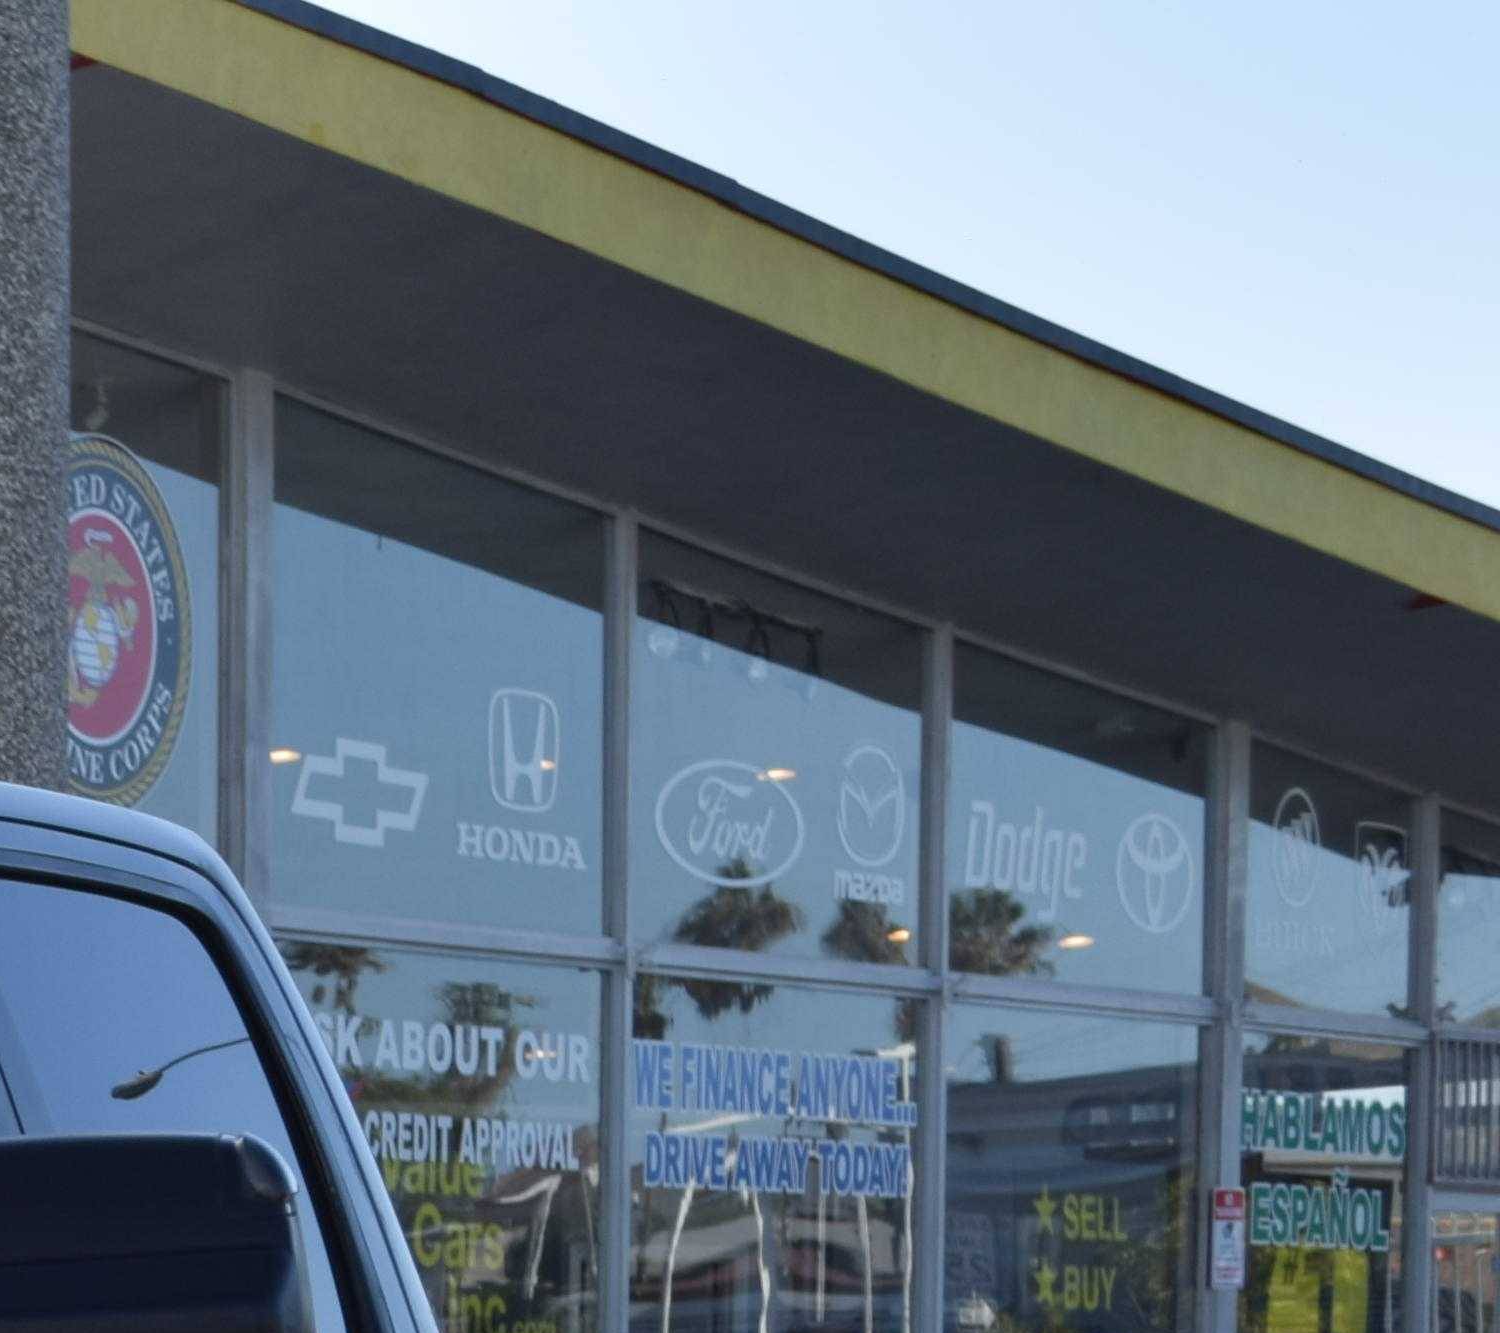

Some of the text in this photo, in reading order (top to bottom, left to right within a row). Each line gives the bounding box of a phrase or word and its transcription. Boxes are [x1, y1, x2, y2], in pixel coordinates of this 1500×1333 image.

[110, 484, 175, 622] STATES
[109, 683, 173, 781] CORPS
[456, 822, 588, 870] HONDA
[689, 776, 773, 859] Ford
[964, 801, 1087, 920] Dodge
[313, 1011, 591, 1083] SK ABOUT OUR
[634, 1040, 673, 1110] WE
[682, 1044, 791, 1116] FINANCE
[363, 1109, 580, 1171] CREDIT APPROVAL
[1241, 1091, 1406, 1158] HABLAMOS
[645, 1132, 728, 1189] DRIVE
[736, 1138, 810, 1194] AWAY
[412, 1202, 505, 1270] Cars
[1063, 1192, 1128, 1242] SELL
[1252, 1169, 1390, 1251] ESPAÑOL
[1064, 1263, 1116, 1313] BUY
